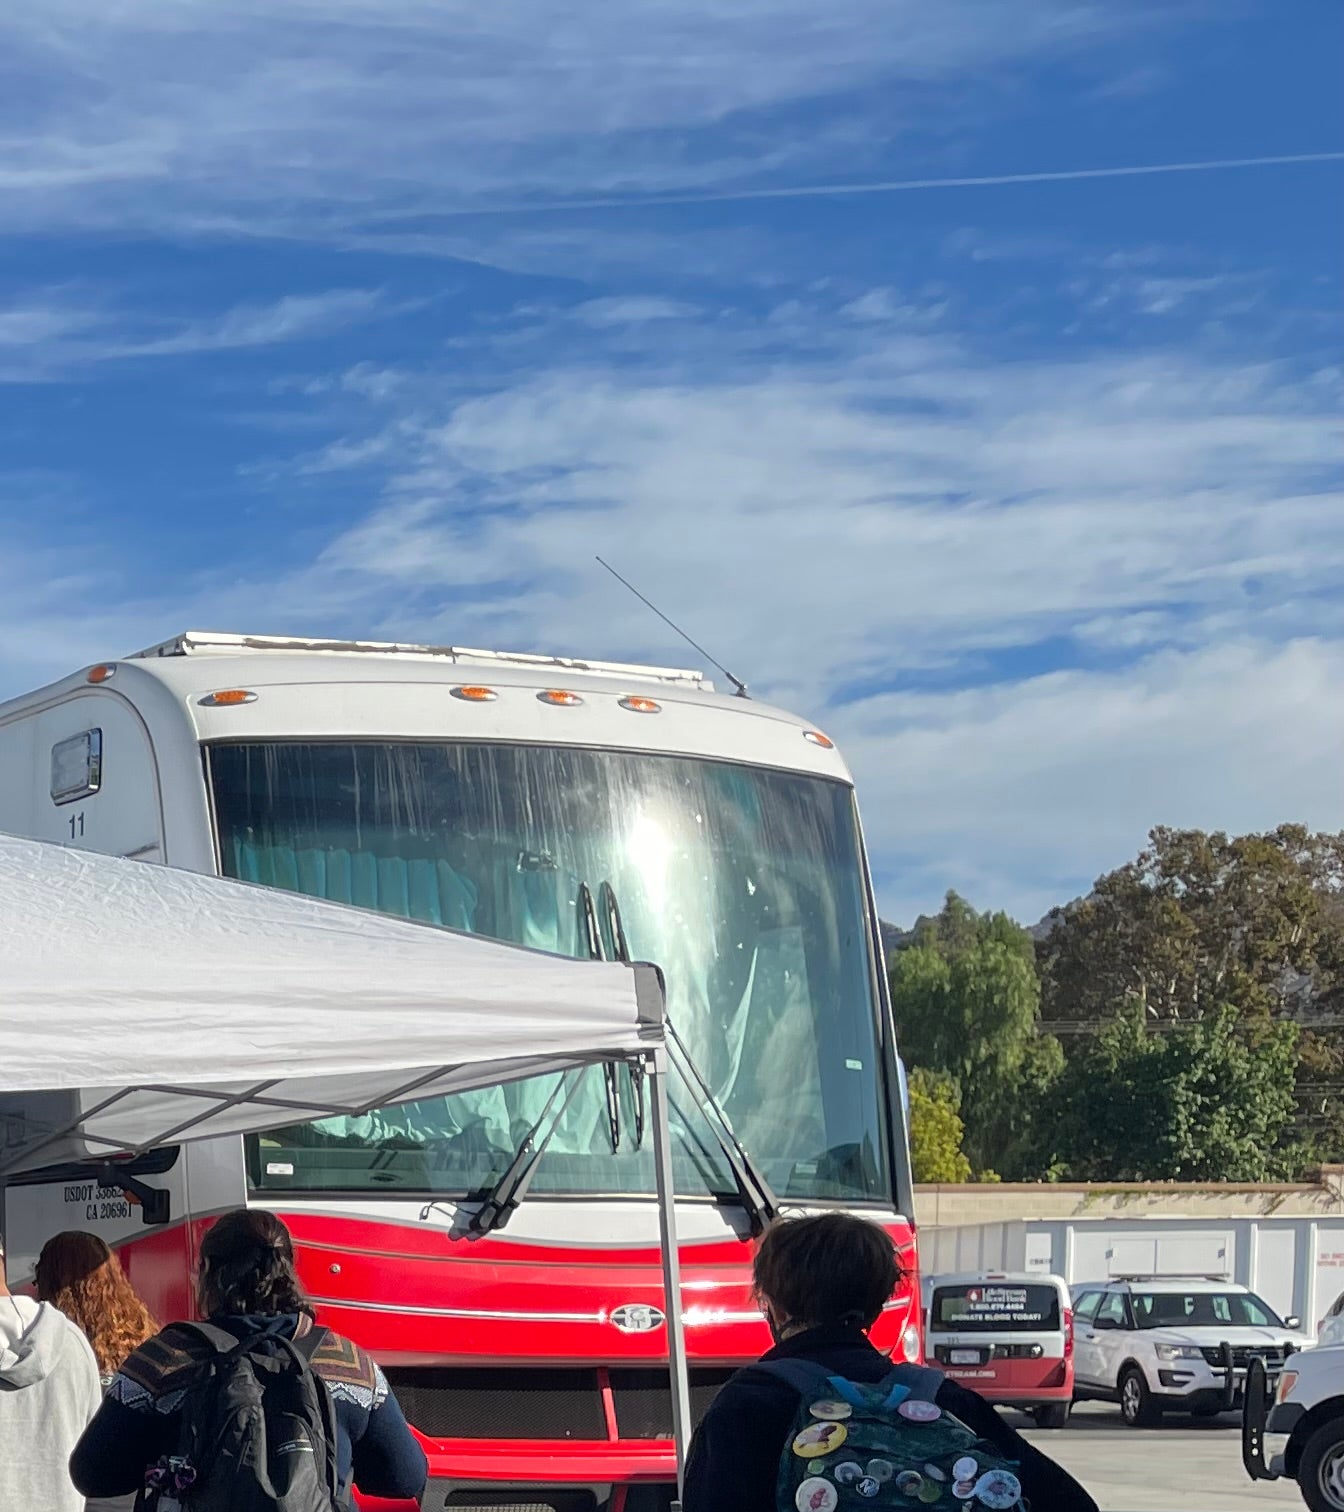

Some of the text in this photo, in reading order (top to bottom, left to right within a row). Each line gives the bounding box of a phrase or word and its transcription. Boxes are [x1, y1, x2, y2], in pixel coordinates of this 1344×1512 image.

[69, 811, 85, 839] 11
[64, 1184, 94, 1202] USDOT
[86, 1202, 132, 1220] CA 206961
